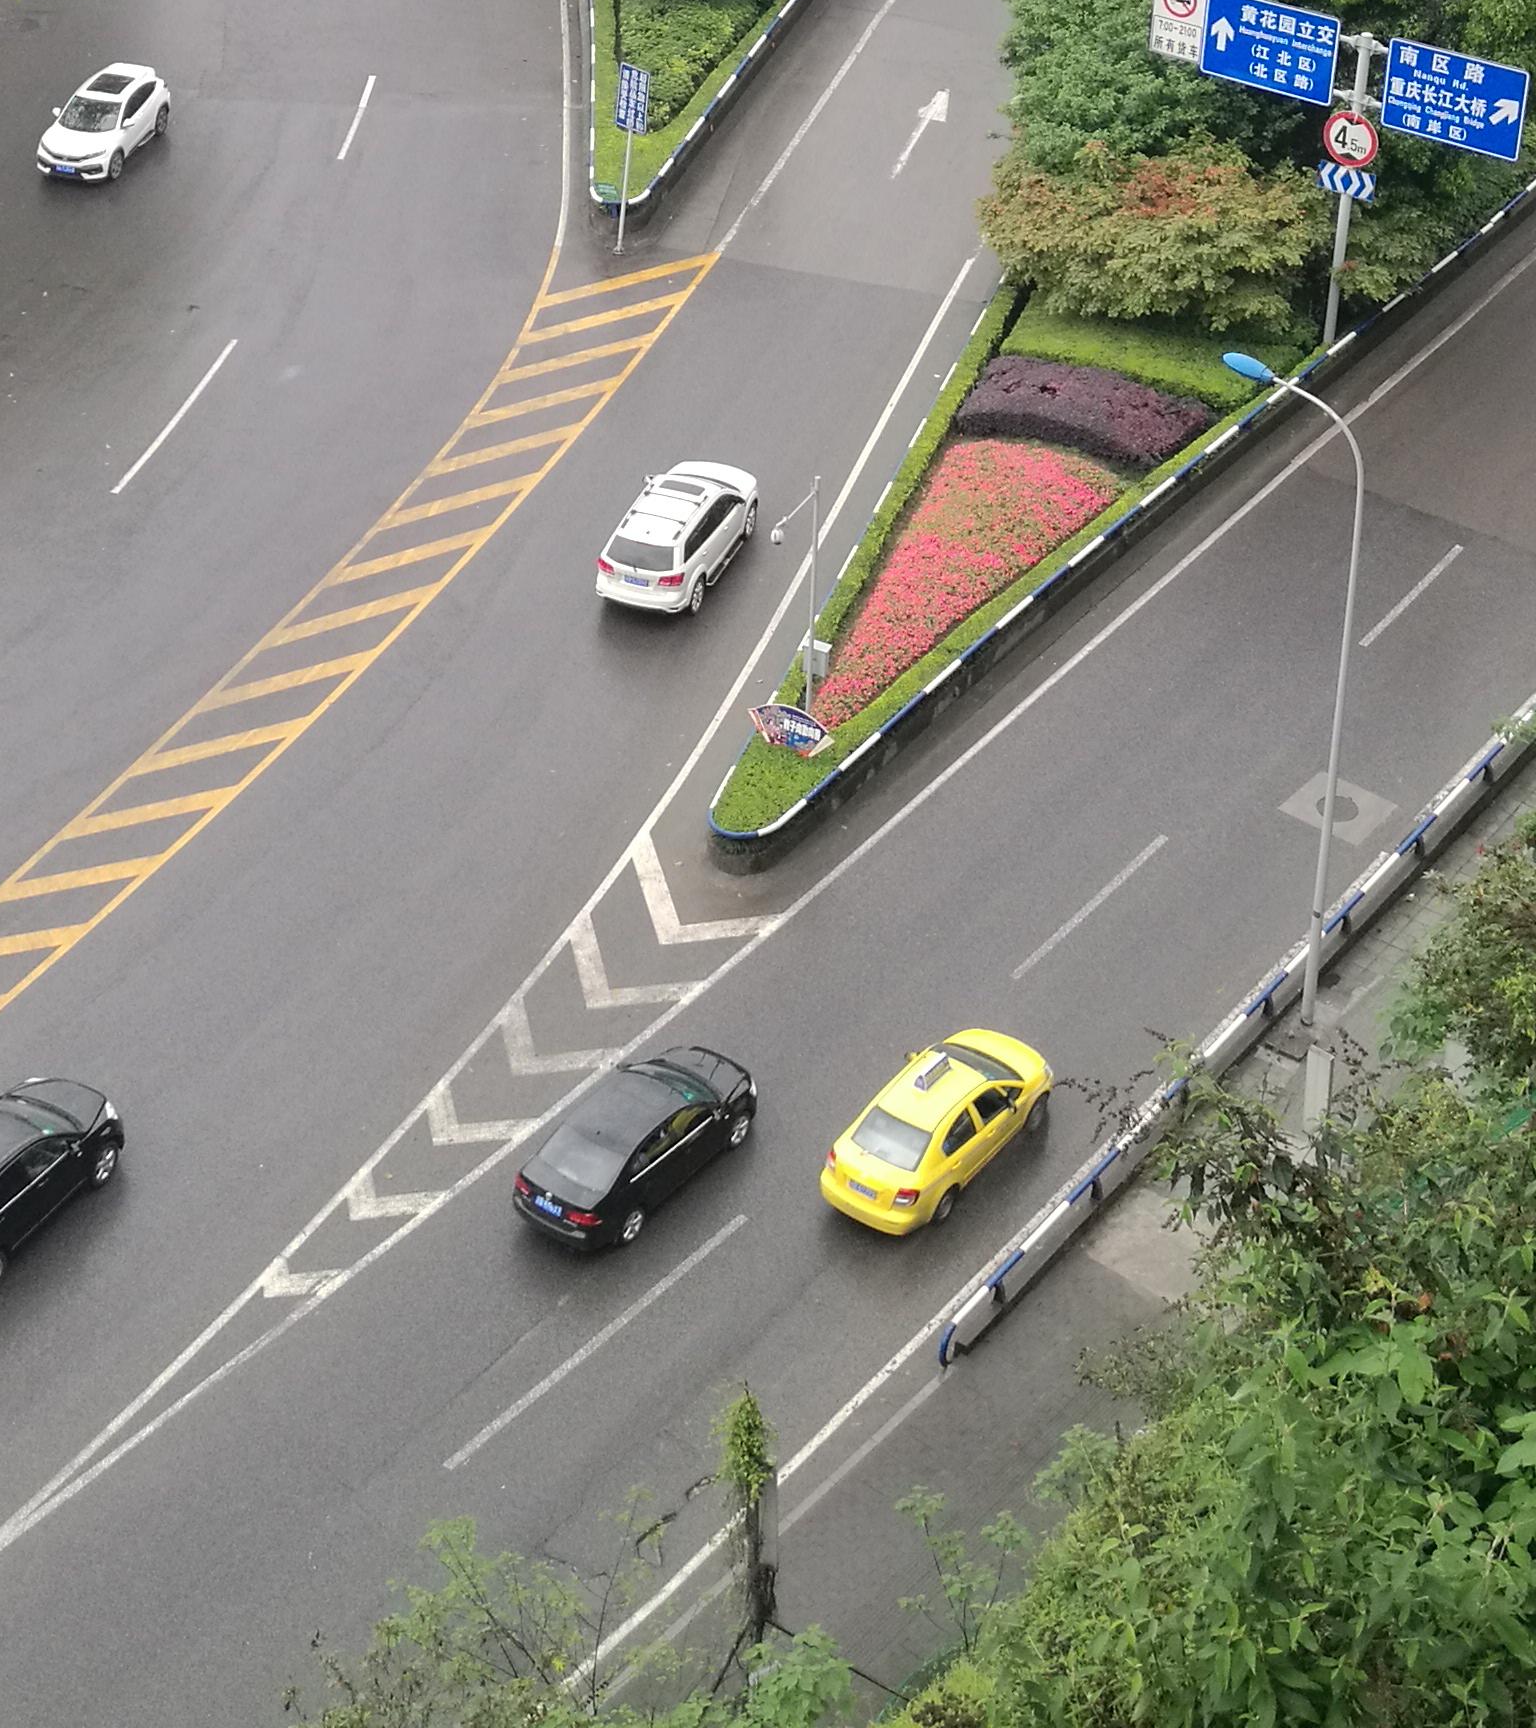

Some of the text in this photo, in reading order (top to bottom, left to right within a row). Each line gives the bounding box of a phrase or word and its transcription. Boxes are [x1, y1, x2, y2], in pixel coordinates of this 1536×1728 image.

[1239, 4, 1336, 46] 黄花园立交
[1153, 35, 1199, 59] 所有货车
[1399, 45, 1486, 85] 南区路
[1389, 76, 1488, 119] 重庆长江大桥
[1413, 69, 1447, 87] Nanqu
